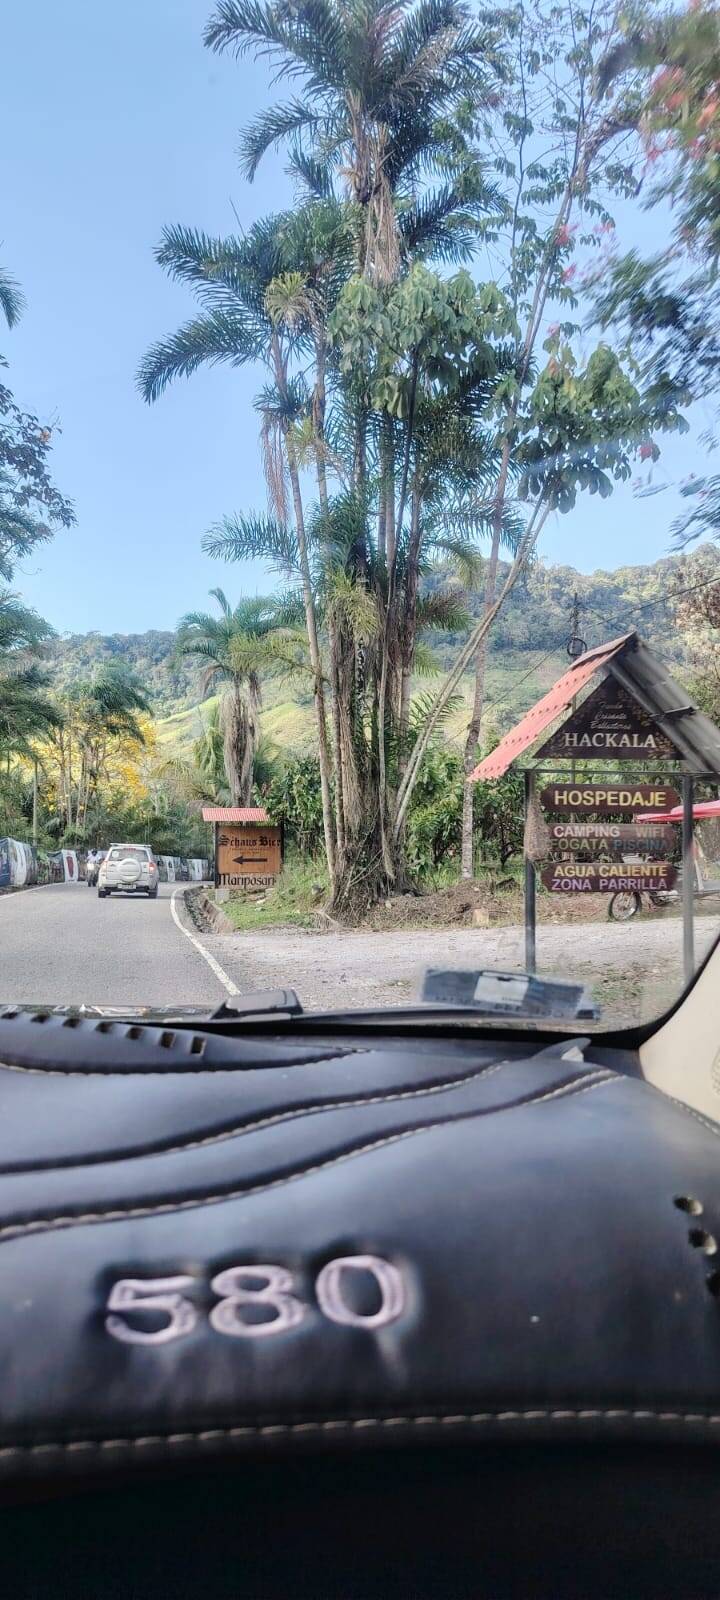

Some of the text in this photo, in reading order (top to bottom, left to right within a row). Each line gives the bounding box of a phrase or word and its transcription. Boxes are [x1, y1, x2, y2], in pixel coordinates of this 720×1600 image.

[564, 732, 657, 748] HACKALA
[554, 790, 667, 807] HOSPEDAJE
[554, 825, 665, 838] CAMPING WIFI
[550, 838, 668, 851] FOGATA PISCINA
[554, 865, 668, 877] AGUA CALIENTE
[218, 873, 276, 889] Mariposari
[551, 878, 668, 891] ZONA PARRILLA
[105, 1255, 405, 1345] 580
